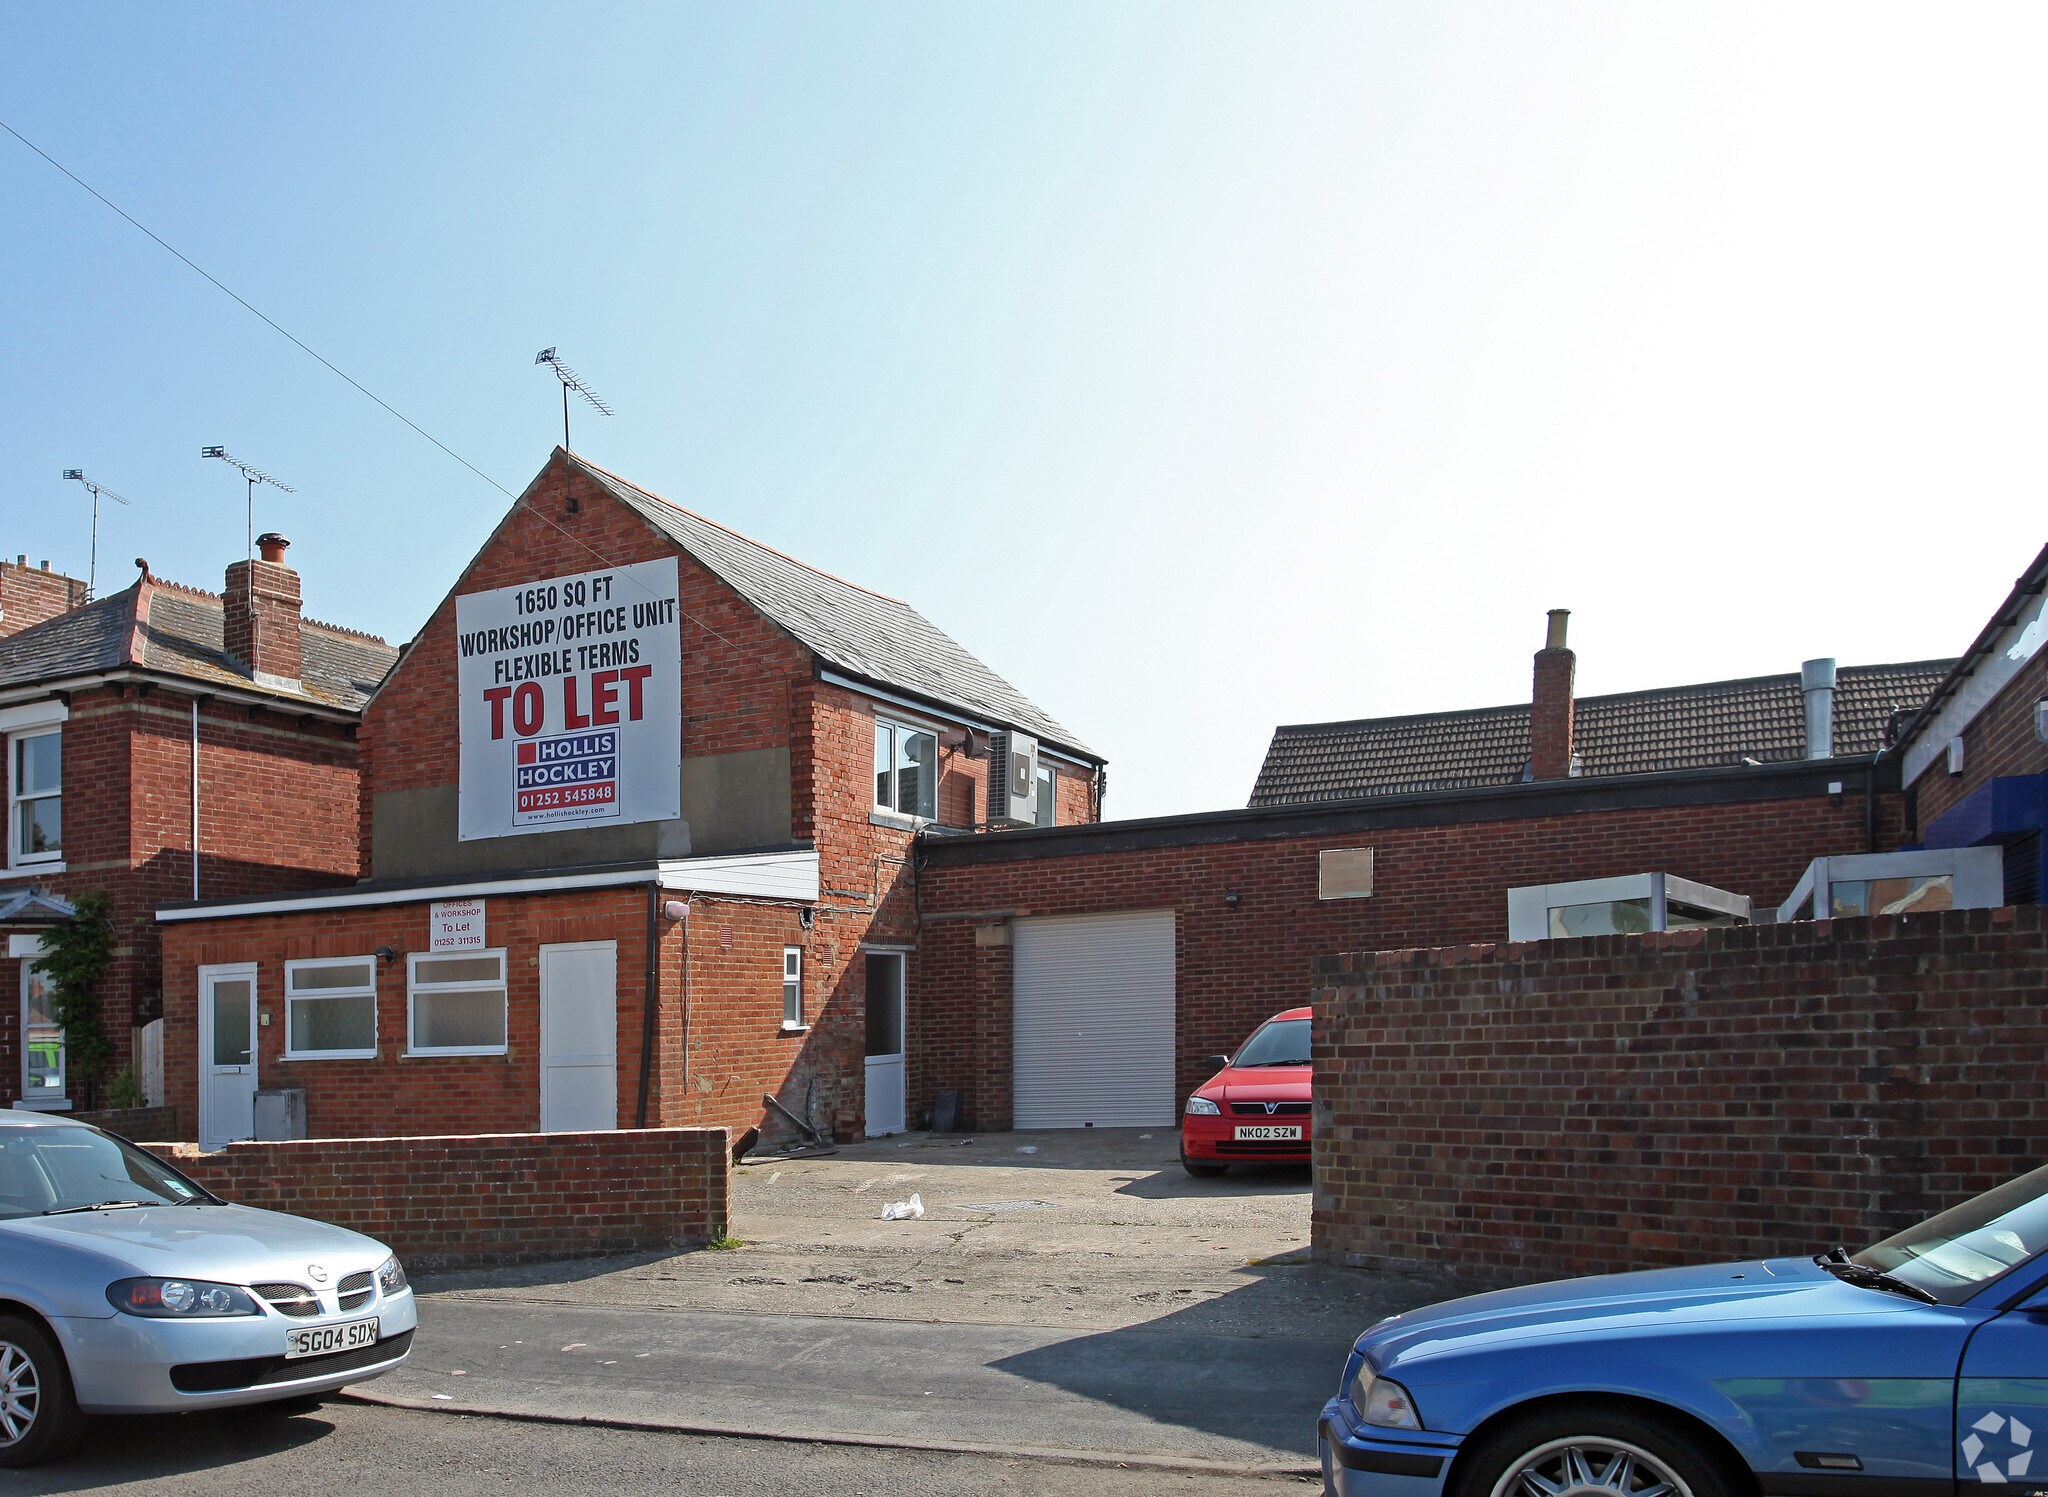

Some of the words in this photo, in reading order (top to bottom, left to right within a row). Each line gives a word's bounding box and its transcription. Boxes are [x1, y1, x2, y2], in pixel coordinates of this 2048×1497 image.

[515, 587, 557, 615] 1650
[563, 580, 586, 608] SQ
[592, 576, 613, 603] FT
[460, 607, 626, 658] WORKSHOP/OFFICE
[633, 598, 676, 629] UNIT
[495, 649, 572, 684] FLEXIBLE
[578, 638, 640, 670] TERMS
[483, 681, 545, 740] TO
[563, 664, 652, 730] LET
[542, 736, 612, 759] HOLLIS
[520, 760, 612, 785] HOCKLEY
[521, 792, 559, 808] 01252
[564, 786, 612, 803] 545848
[528, 807, 605, 820] www.hollishockley.com
[441, 909, 481, 918] WORKSHOP
[443, 900, 472, 908] OFFICES
[442, 923, 453, 932] To
[455, 922, 470, 931] Let
[434, 938, 455, 946] 01252
[458, 936, 481, 944] 311315
[1240, 1128, 1270, 1138] NK02
[1273, 1128, 1297, 1138] SZW
[299, 1328, 343, 1353] SG04
[348, 1322, 375, 1346] SDX
